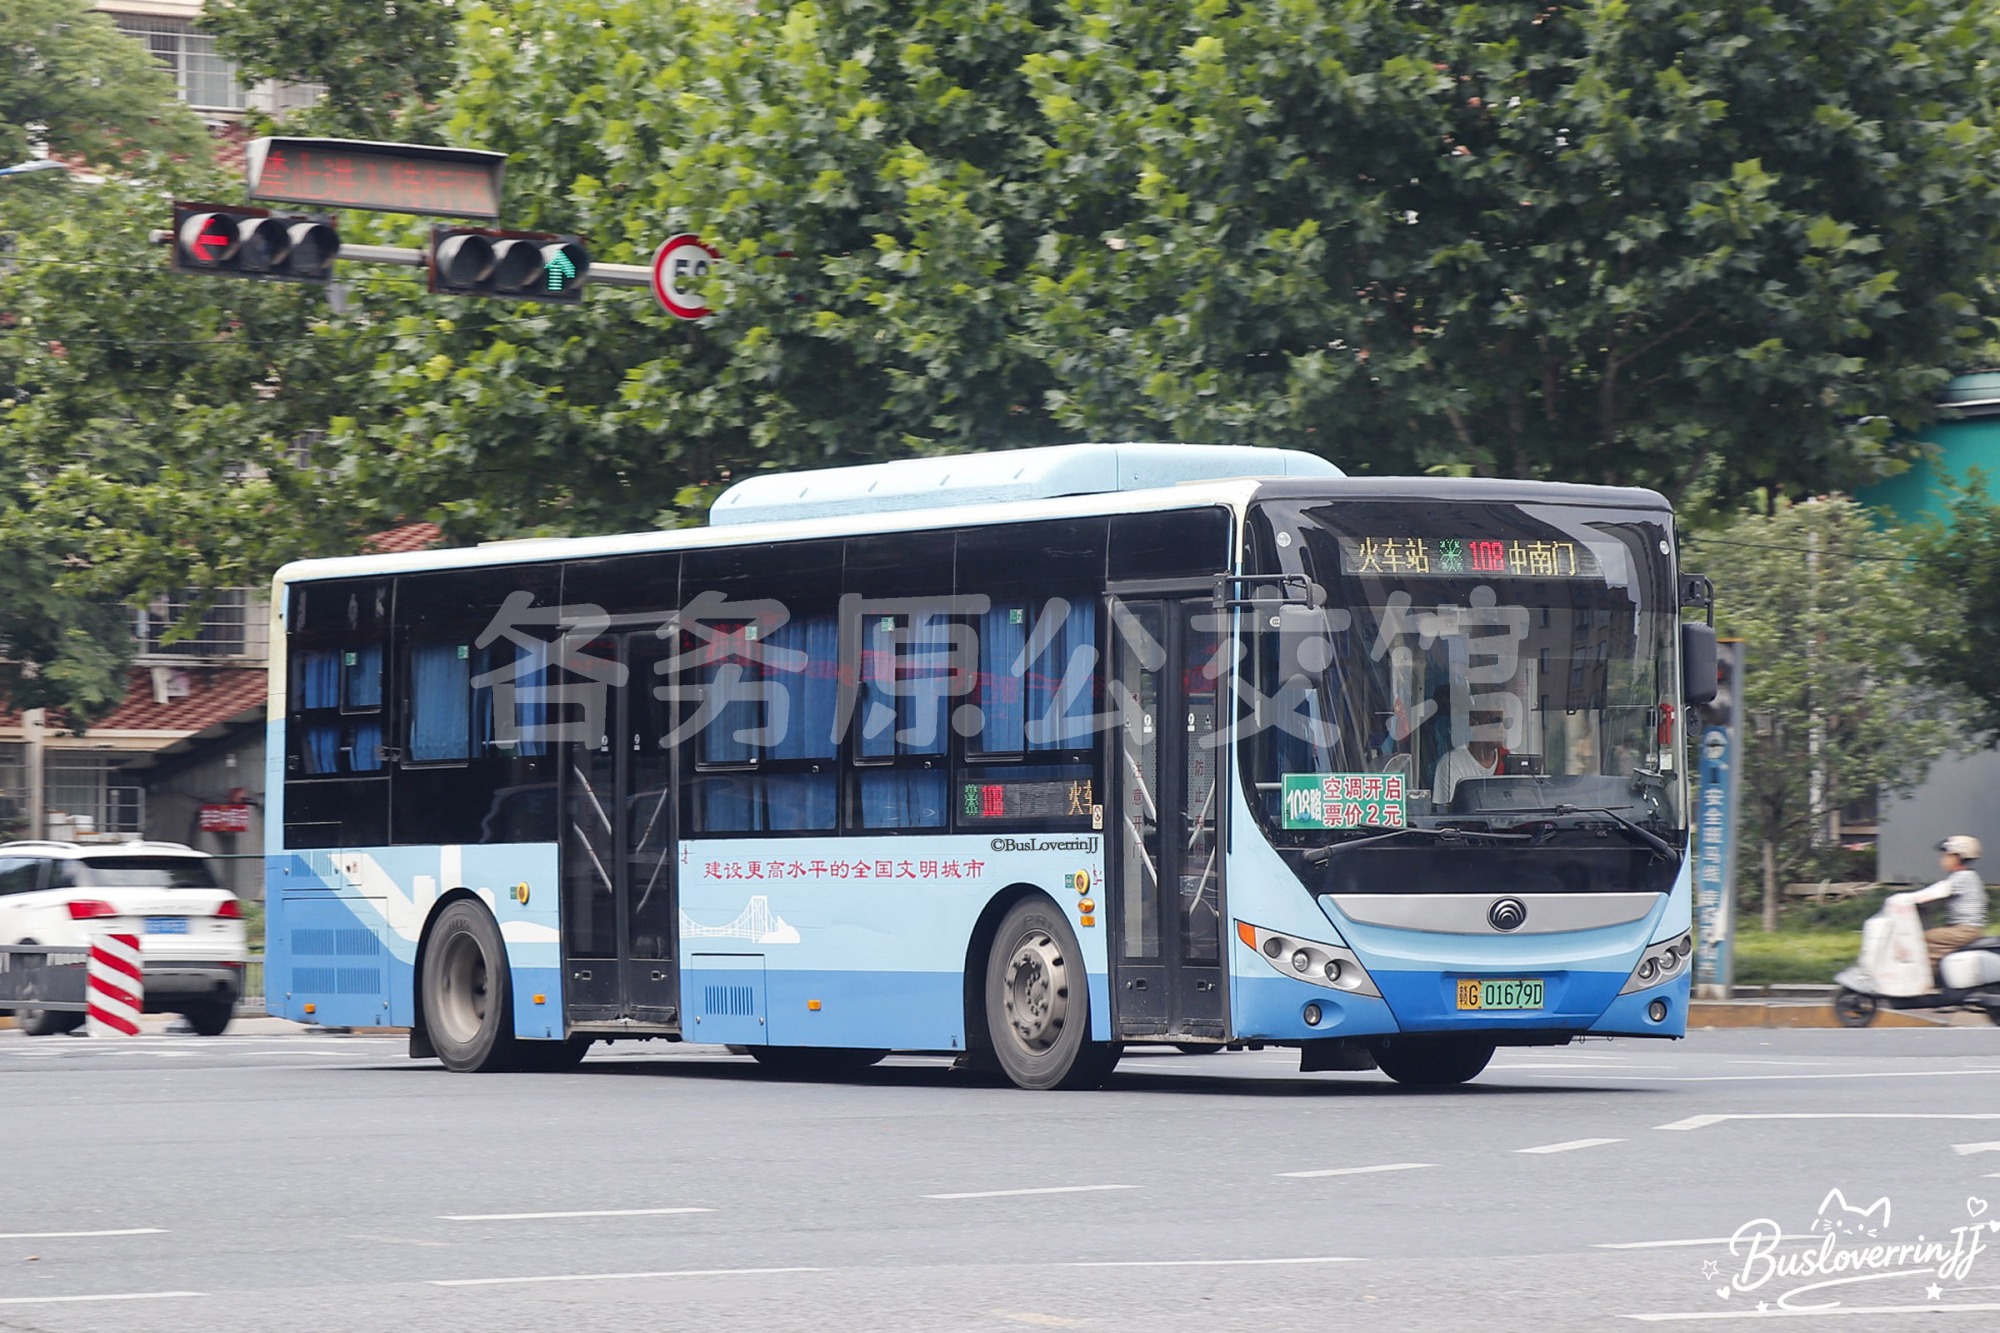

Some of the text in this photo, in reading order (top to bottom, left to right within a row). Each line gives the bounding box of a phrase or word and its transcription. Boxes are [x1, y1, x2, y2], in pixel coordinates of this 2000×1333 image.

[1359, 537, 1576, 576] 火车站 108 中南门
[1323, 777, 1402, 800] 空调开启
[1287, 788, 1322, 821] 108路
[1323, 803, 1402, 827] 票价2元
[703, 858, 986, 880] 建设更高水平的全国文明城市
